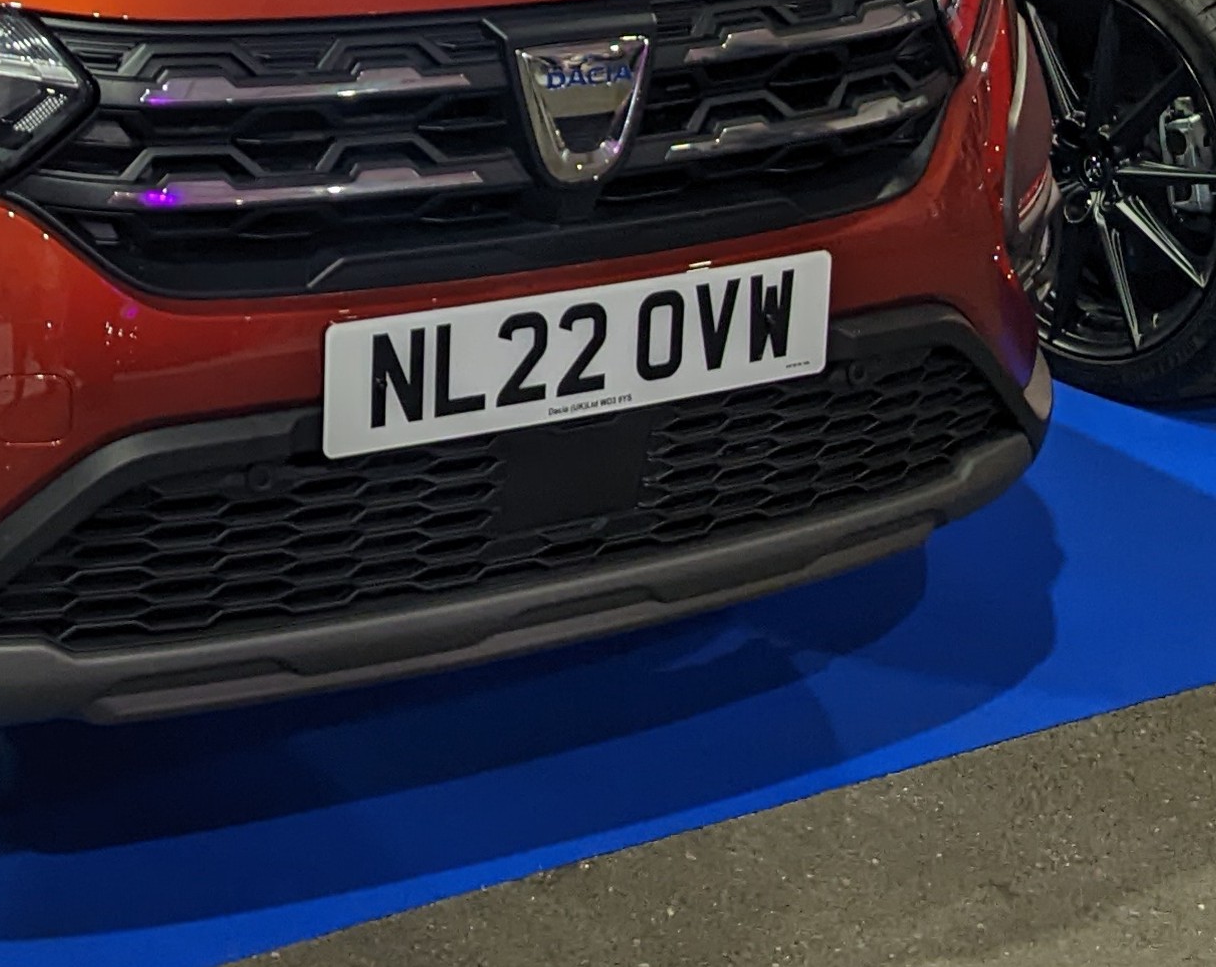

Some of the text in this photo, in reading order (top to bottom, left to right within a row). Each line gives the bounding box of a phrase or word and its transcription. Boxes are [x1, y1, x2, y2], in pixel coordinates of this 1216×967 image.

[545, 64, 634, 89] DACIA
[370, 269, 795, 429] NL22 OVW
